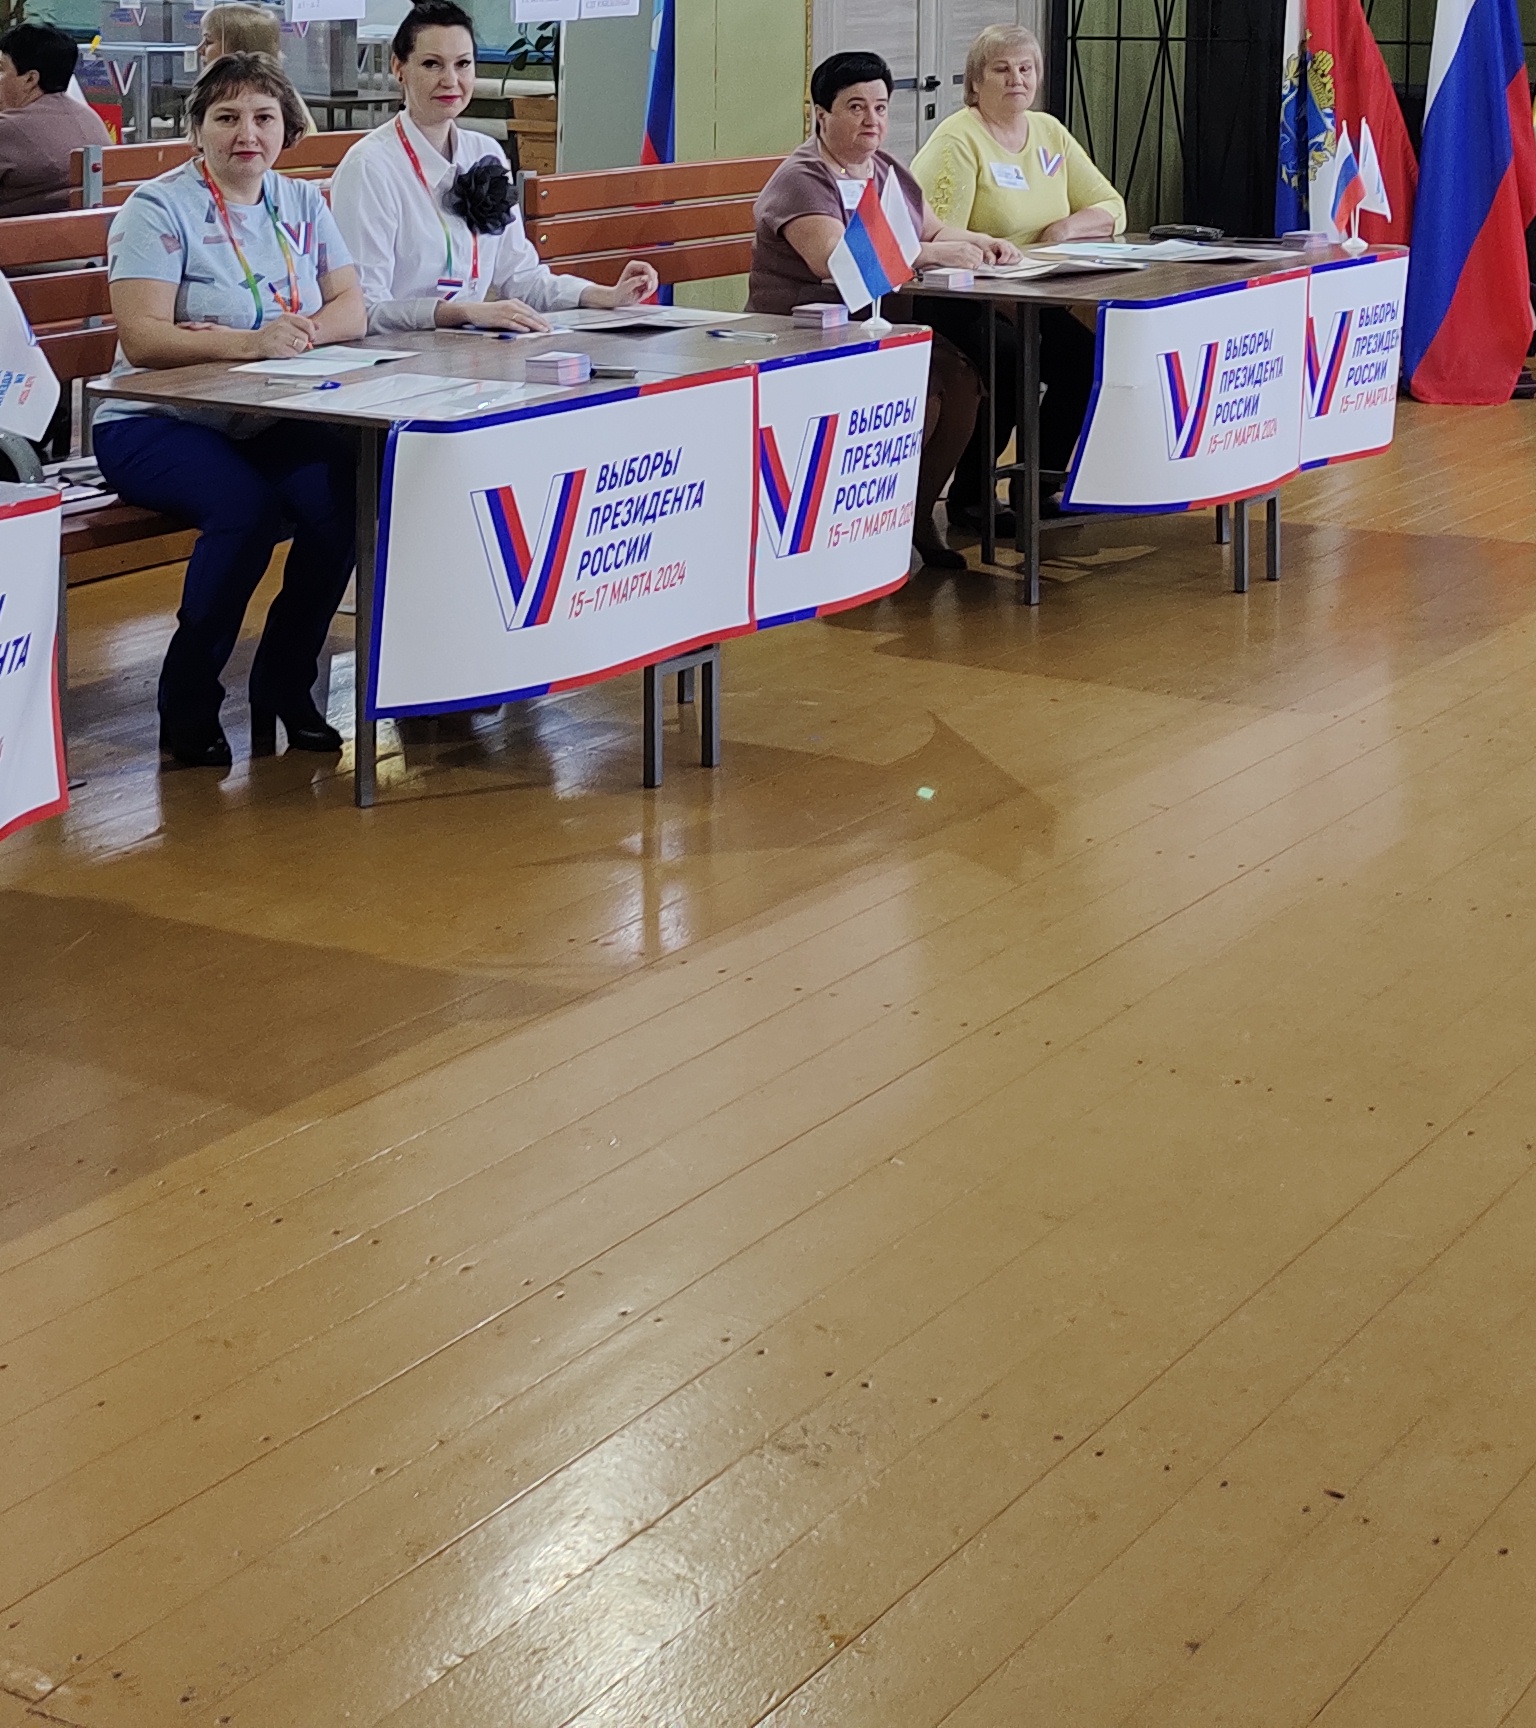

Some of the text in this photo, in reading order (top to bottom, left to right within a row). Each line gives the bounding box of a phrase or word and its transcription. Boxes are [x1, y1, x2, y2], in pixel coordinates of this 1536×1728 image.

[1358, 299, 1400, 329] ВЫБОРЫ
[1224, 328, 1274, 362] ВЫБОРЫ
[1219, 354, 1285, 394] ПРЕЗИДЕНТА
[1344, 358, 1389, 389] РОССИИ
[847, 396, 918, 437] ВЫБОРЫ
[1213, 392, 1261, 427] РОССИИ
[840, 428, 924, 476] ПРЕЗИДЕНТ
[1232, 421, 1261, 449] МАРТА
[595, 446, 683, 495] ВЫБОРЫ
[586, 479, 706, 538] ПРЕЗИДЕНТА
[832, 472, 899, 515] РОССИИ
[862, 506, 899, 540] МАРТА
[575, 530, 654, 582] РОССИИ
[609, 569, 653, 608] МАРТА
[653, 559, 687, 594] 2024
